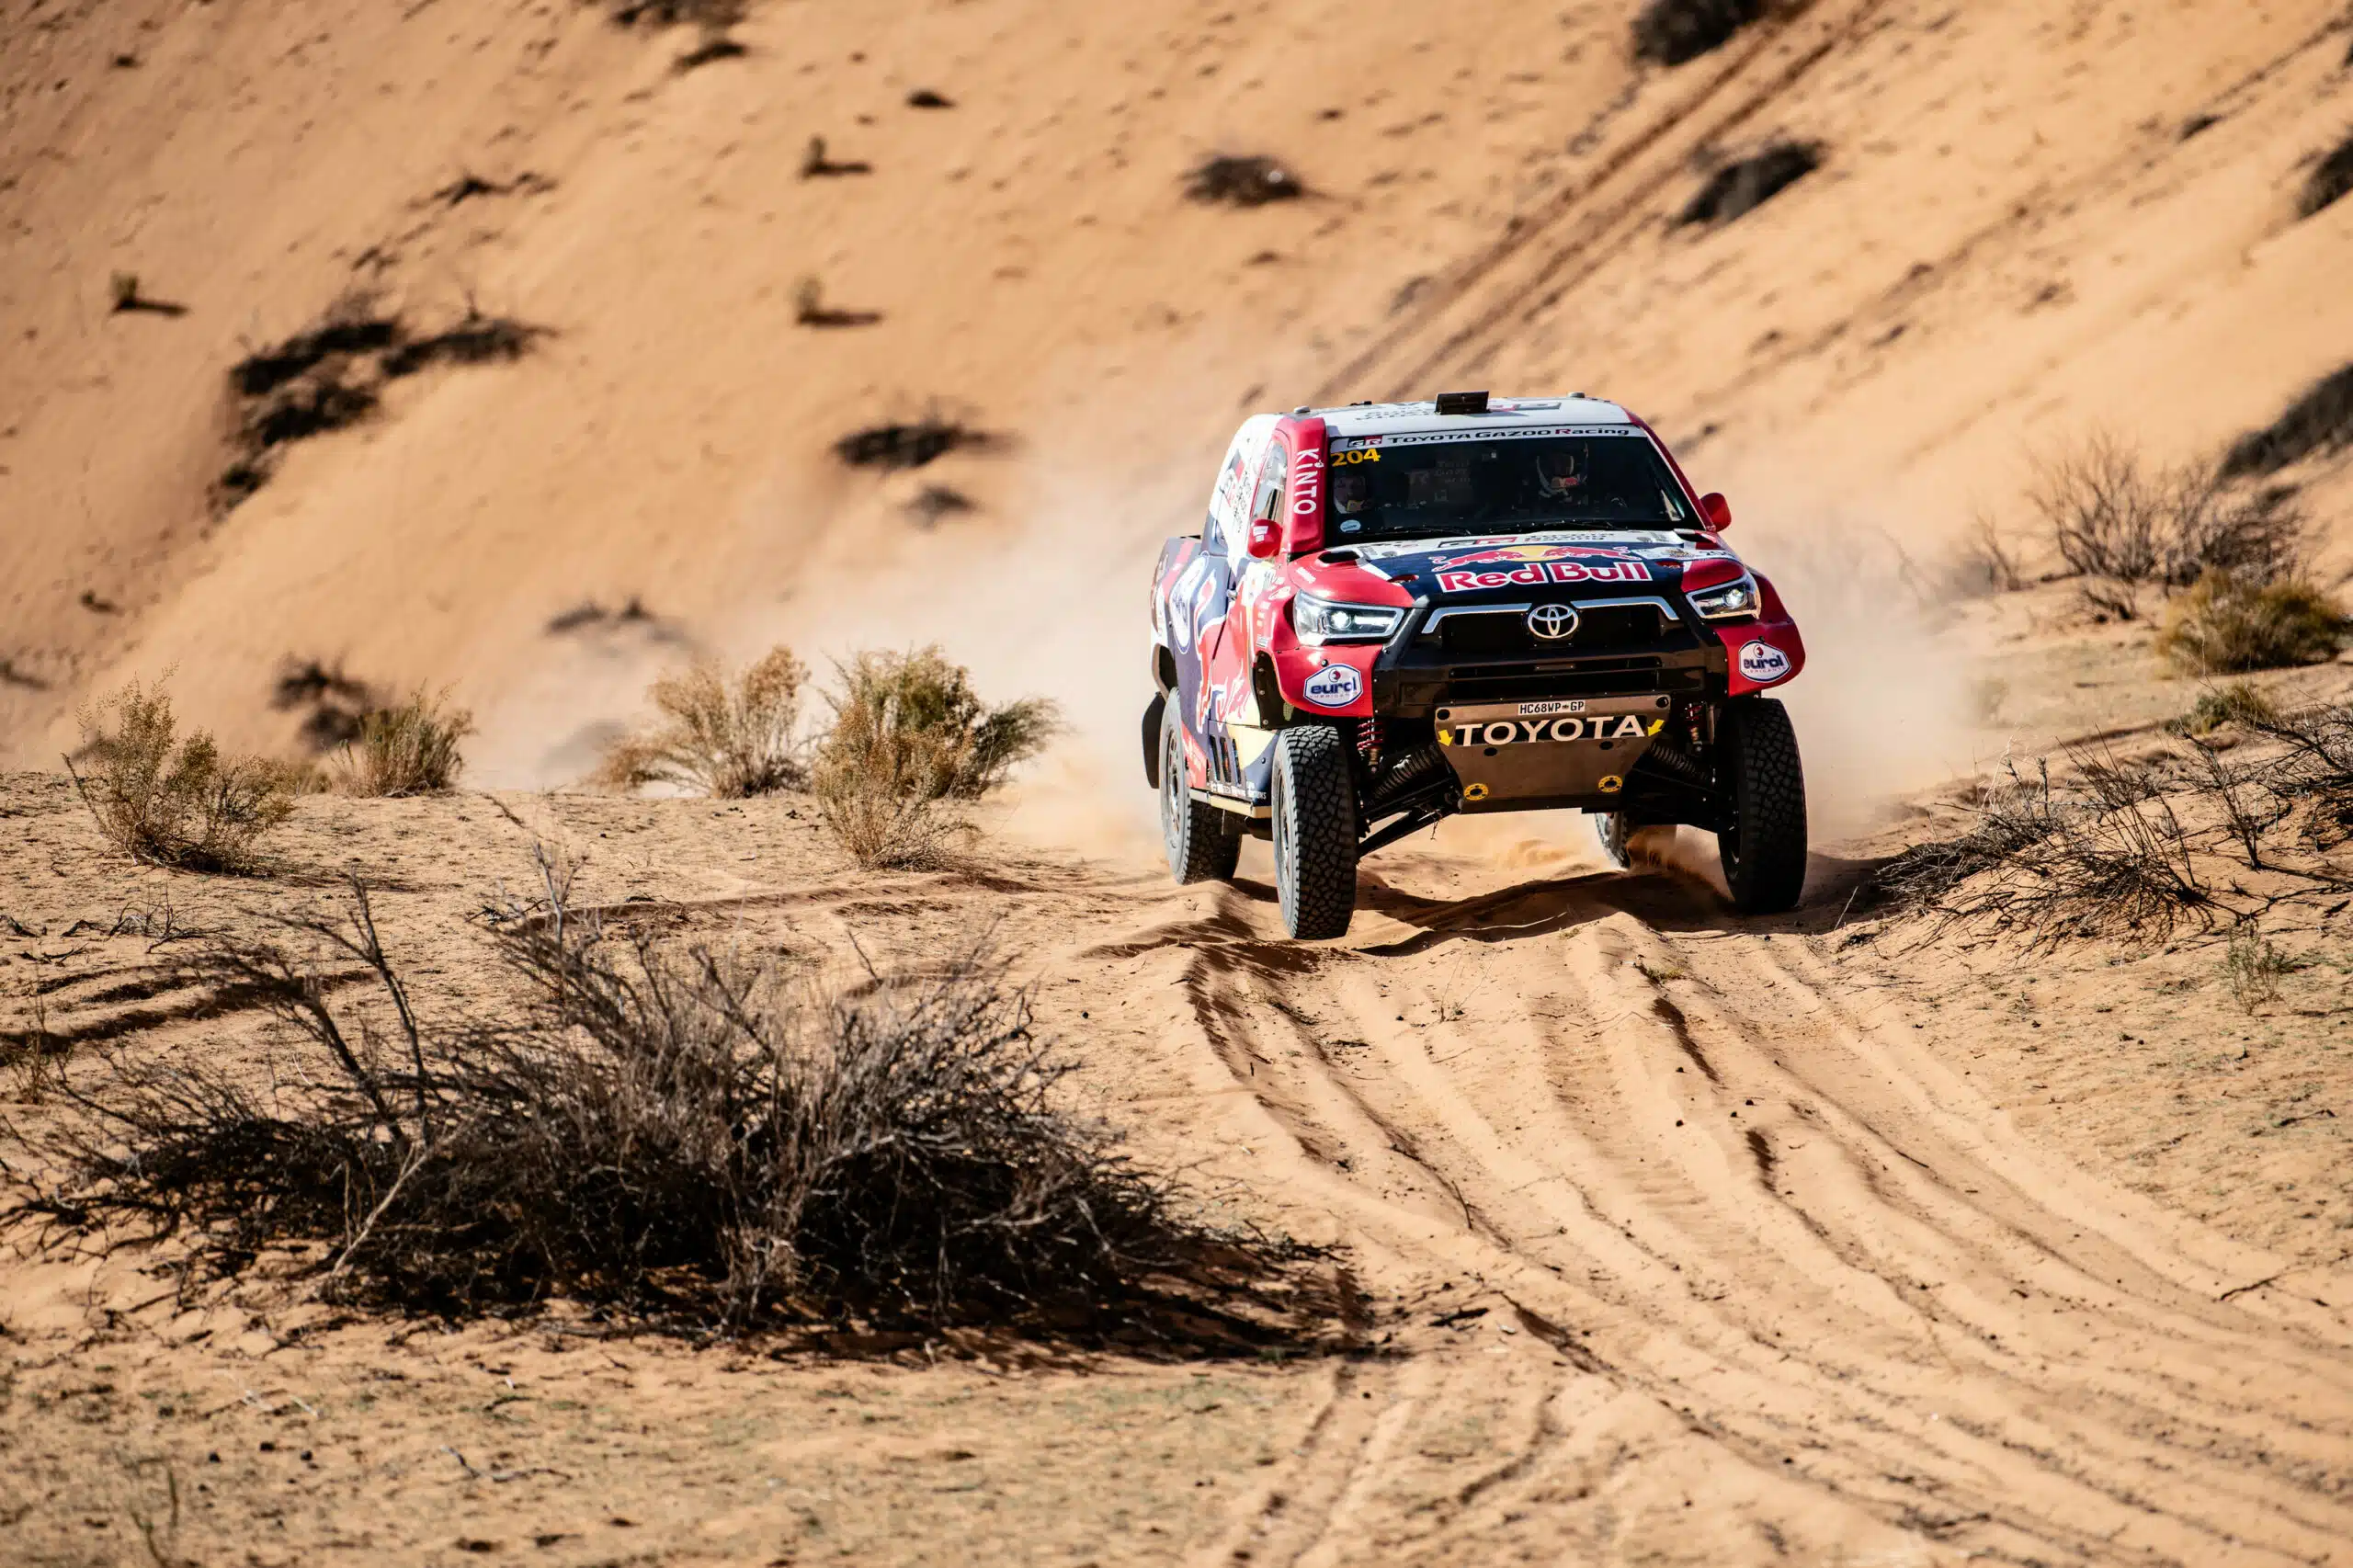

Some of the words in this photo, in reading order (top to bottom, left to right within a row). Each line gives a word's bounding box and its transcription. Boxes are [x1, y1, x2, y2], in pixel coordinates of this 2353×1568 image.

[1388, 434, 1471, 443] TOYOTA
[1475, 428, 1551, 438] GAZOO
[1555, 428, 1629, 437] Racing
[1331, 449, 1381, 467] 204
[1435, 562, 1548, 593] Red
[1547, 562, 1653, 583] Bull
[1744, 654, 1783, 669] eurol
[1311, 676, 1357, 694] eurol
[1519, 702, 1562, 714] HC68WP
[1570, 700, 1585, 711] GP
[1455, 715, 1645, 747] TOYOTA
